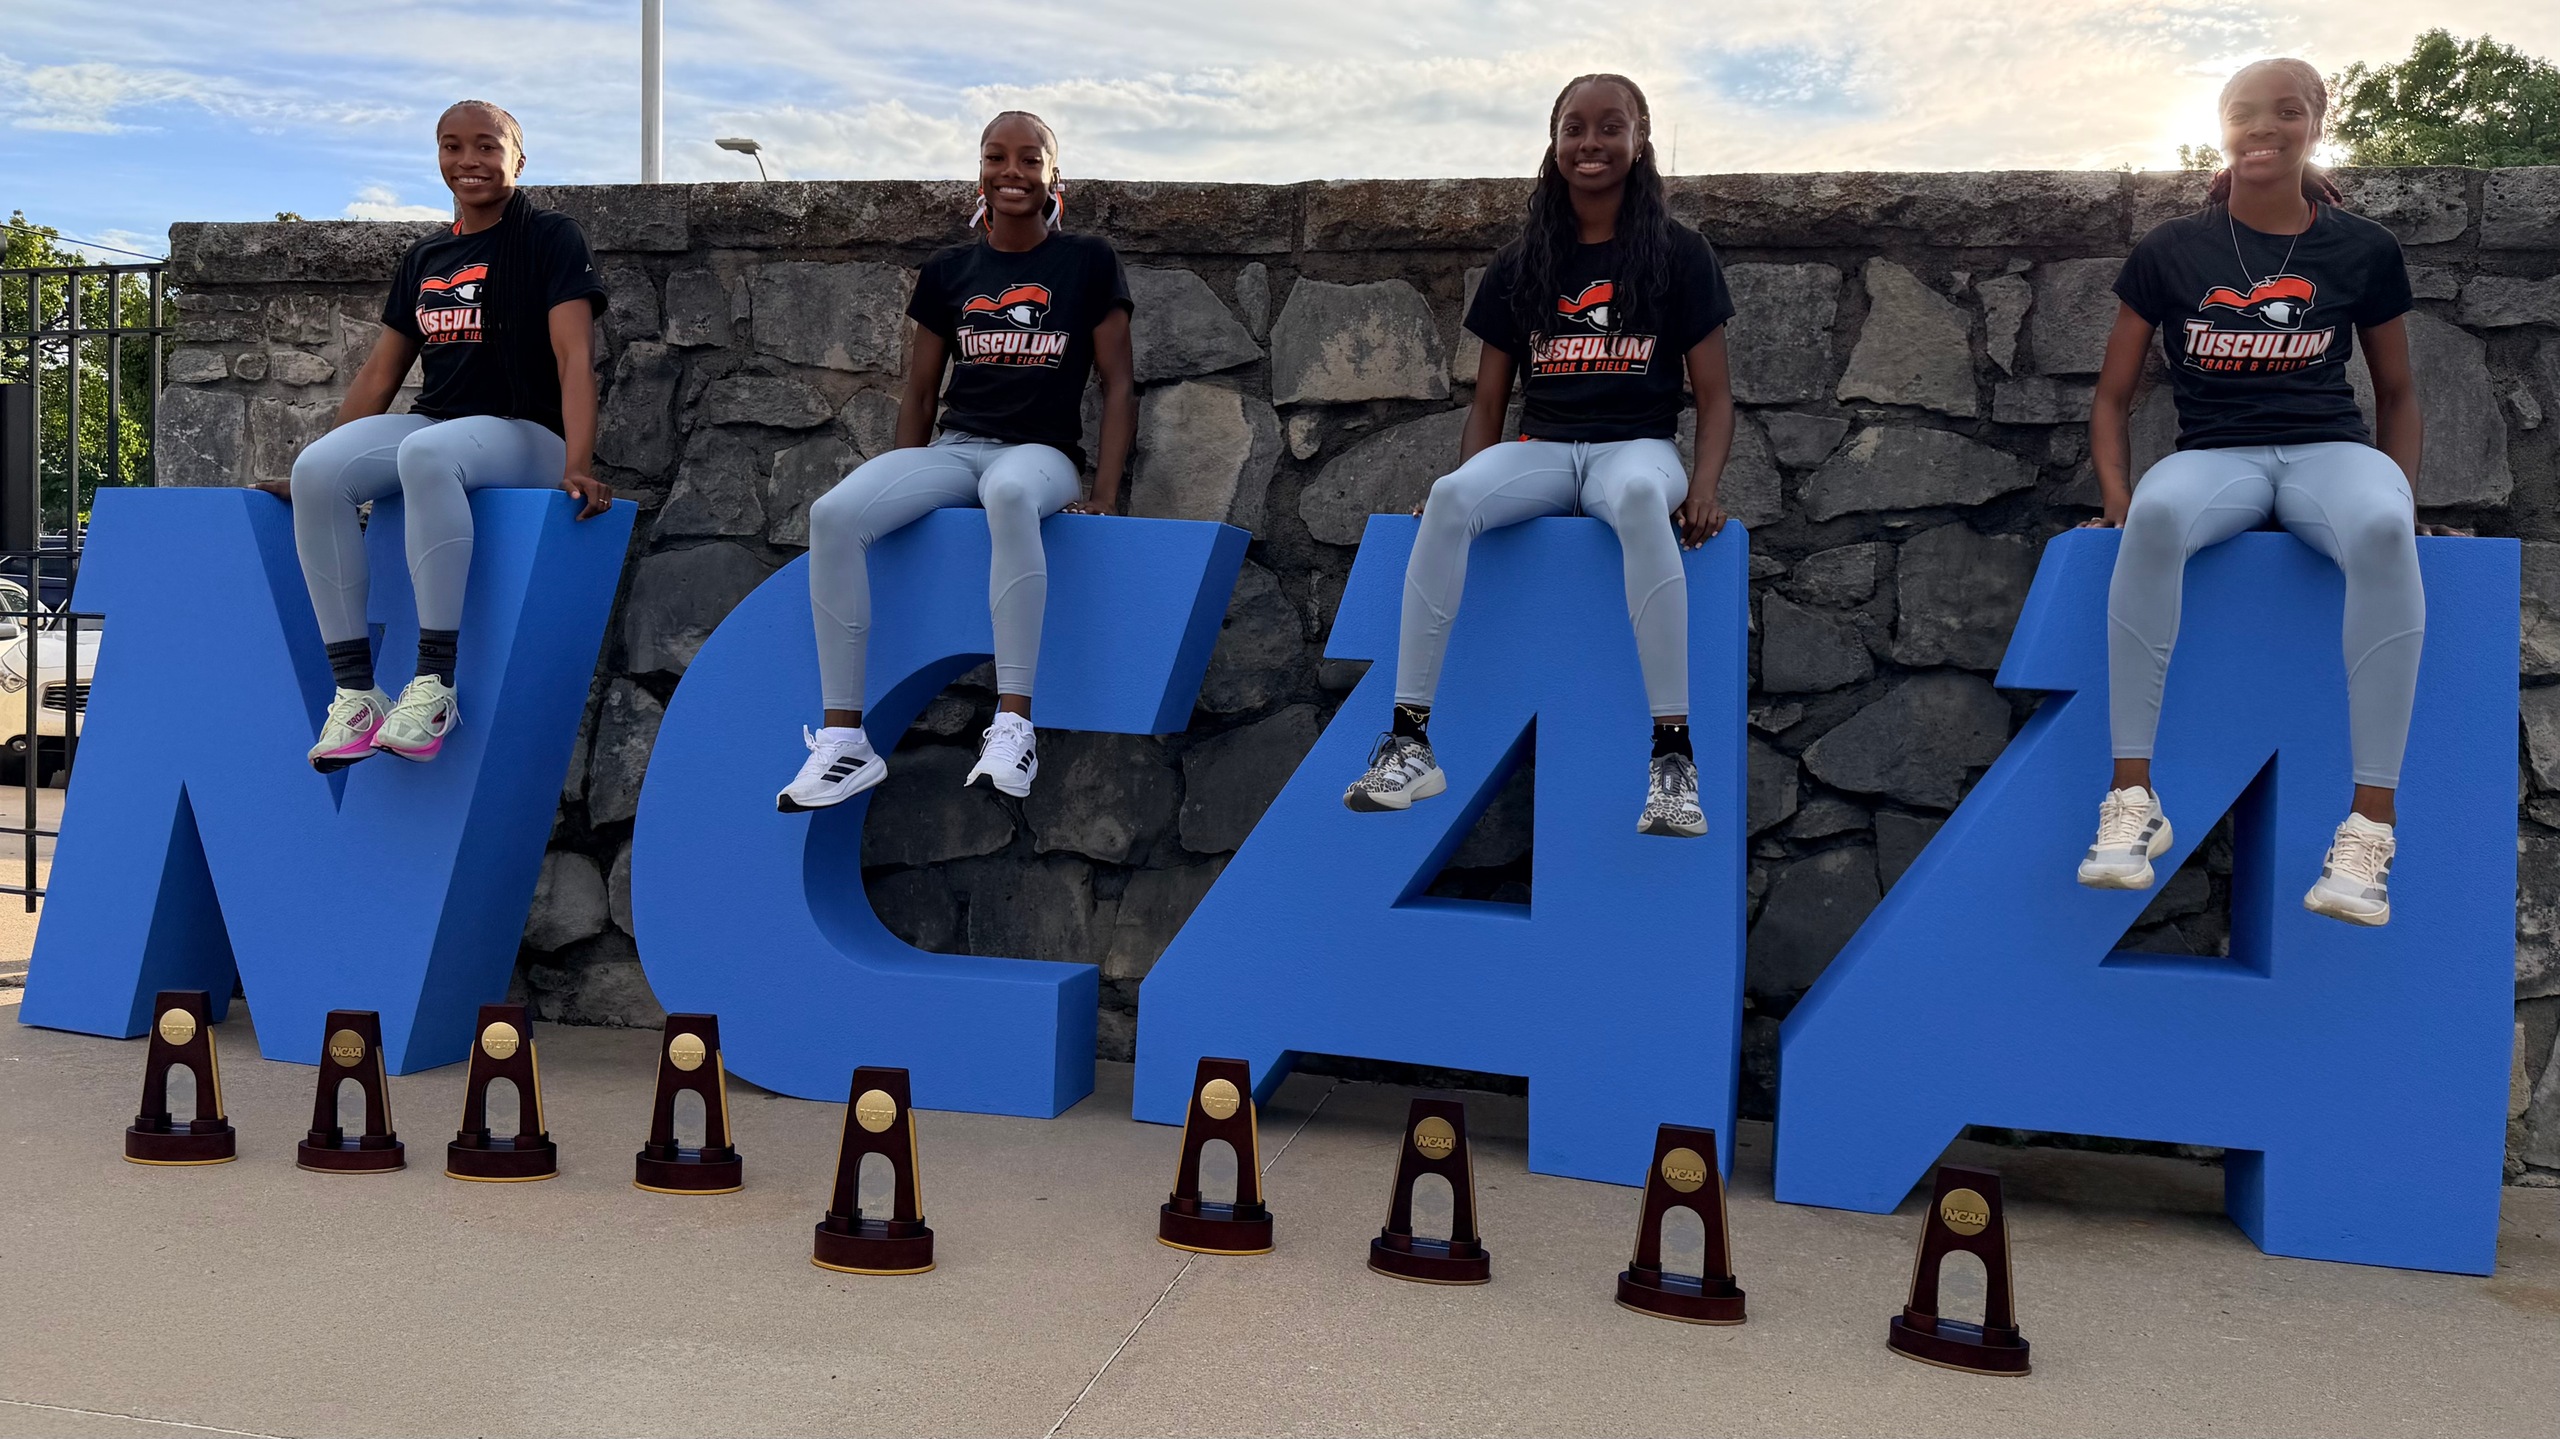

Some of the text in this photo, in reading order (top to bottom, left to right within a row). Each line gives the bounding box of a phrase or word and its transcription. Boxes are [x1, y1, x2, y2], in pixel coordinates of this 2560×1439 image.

[464, 330, 483, 340] FIEL
[2185, 321, 2332, 359] TUSCULUM
[958, 328, 1067, 357] TUSCULUM
[1016, 355, 1047, 365] FIELD
[1541, 360, 1630, 374] TRACK & FIELD
[2200, 358, 2243, 371] TRACK
[332, 1046, 363, 1058] NCAA
[1417, 1135, 1454, 1150] NCAA
[1666, 1167, 1705, 1183] NCAA
[1944, 1207, 1987, 1227] NCAA
